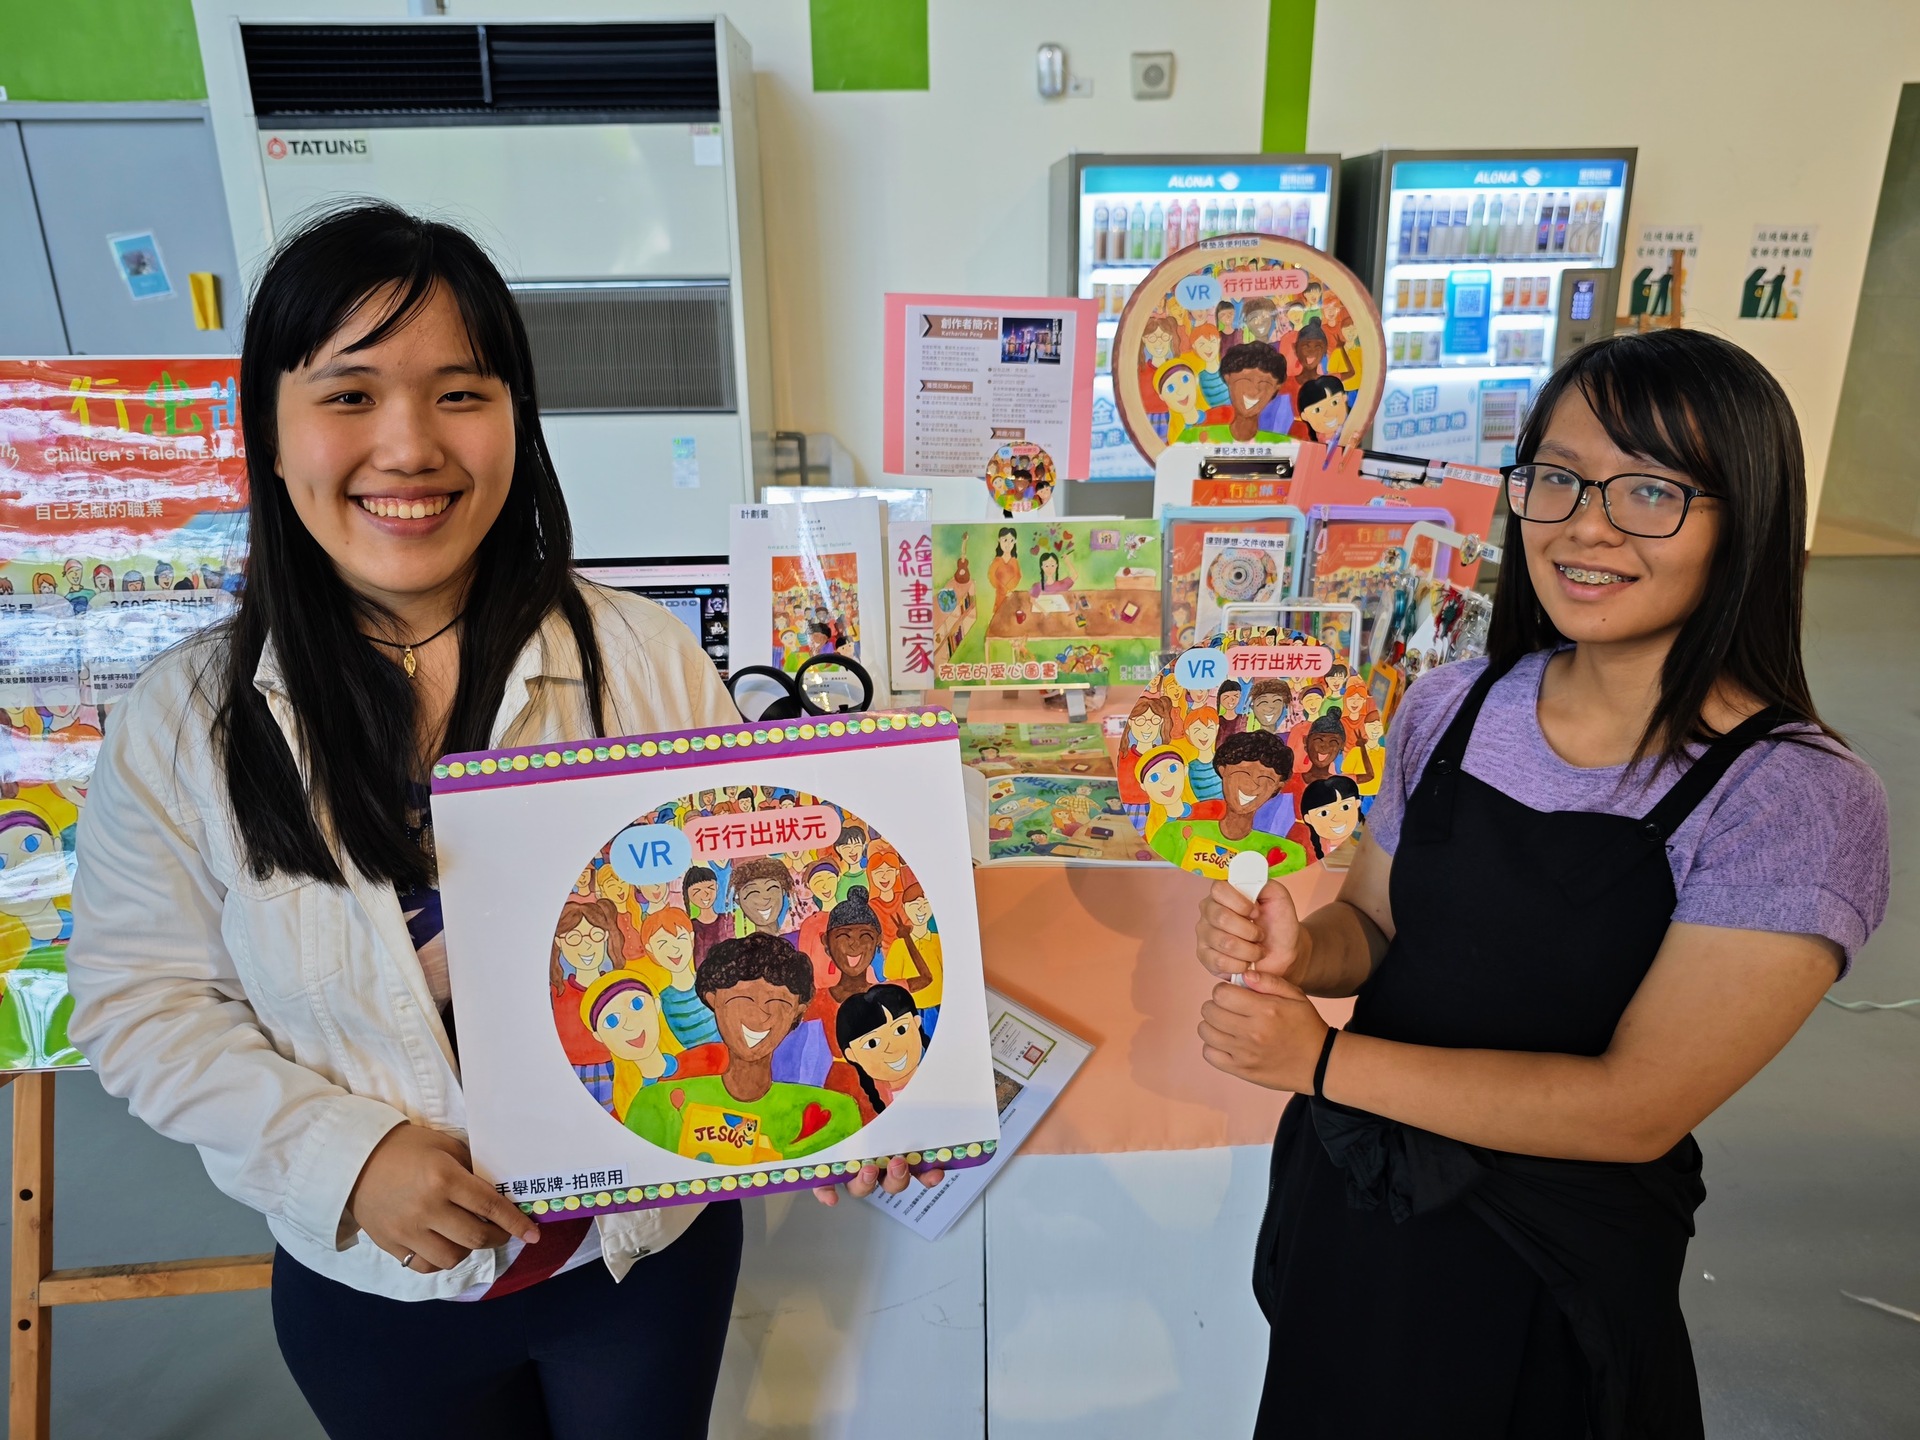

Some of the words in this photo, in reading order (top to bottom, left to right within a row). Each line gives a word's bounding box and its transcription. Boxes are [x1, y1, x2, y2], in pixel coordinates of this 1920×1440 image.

[288, 138, 367, 157] TATUNG
[1186, 284, 1210, 300] VR
[1223, 275, 1299, 293] 行行出狀元
[44, 447, 135, 463] Children's
[141, 446, 193, 461] Talent
[741, 509, 769, 519] 計劃書
[898, 534, 933, 674] 繪畫家
[1187, 660, 1215, 678] VR
[1232, 653, 1322, 671] 行行出狀元
[940, 662, 1058, 681] 亮亮的愛心圖畫
[695, 815, 827, 852] 行行出狀元
[628, 840, 673, 869] VR
[1194, 852, 1227, 869] JESUS
[693, 1126, 746, 1149] JESUS
[495, 1169, 623, 1196] 手舉版牌-拍照用
